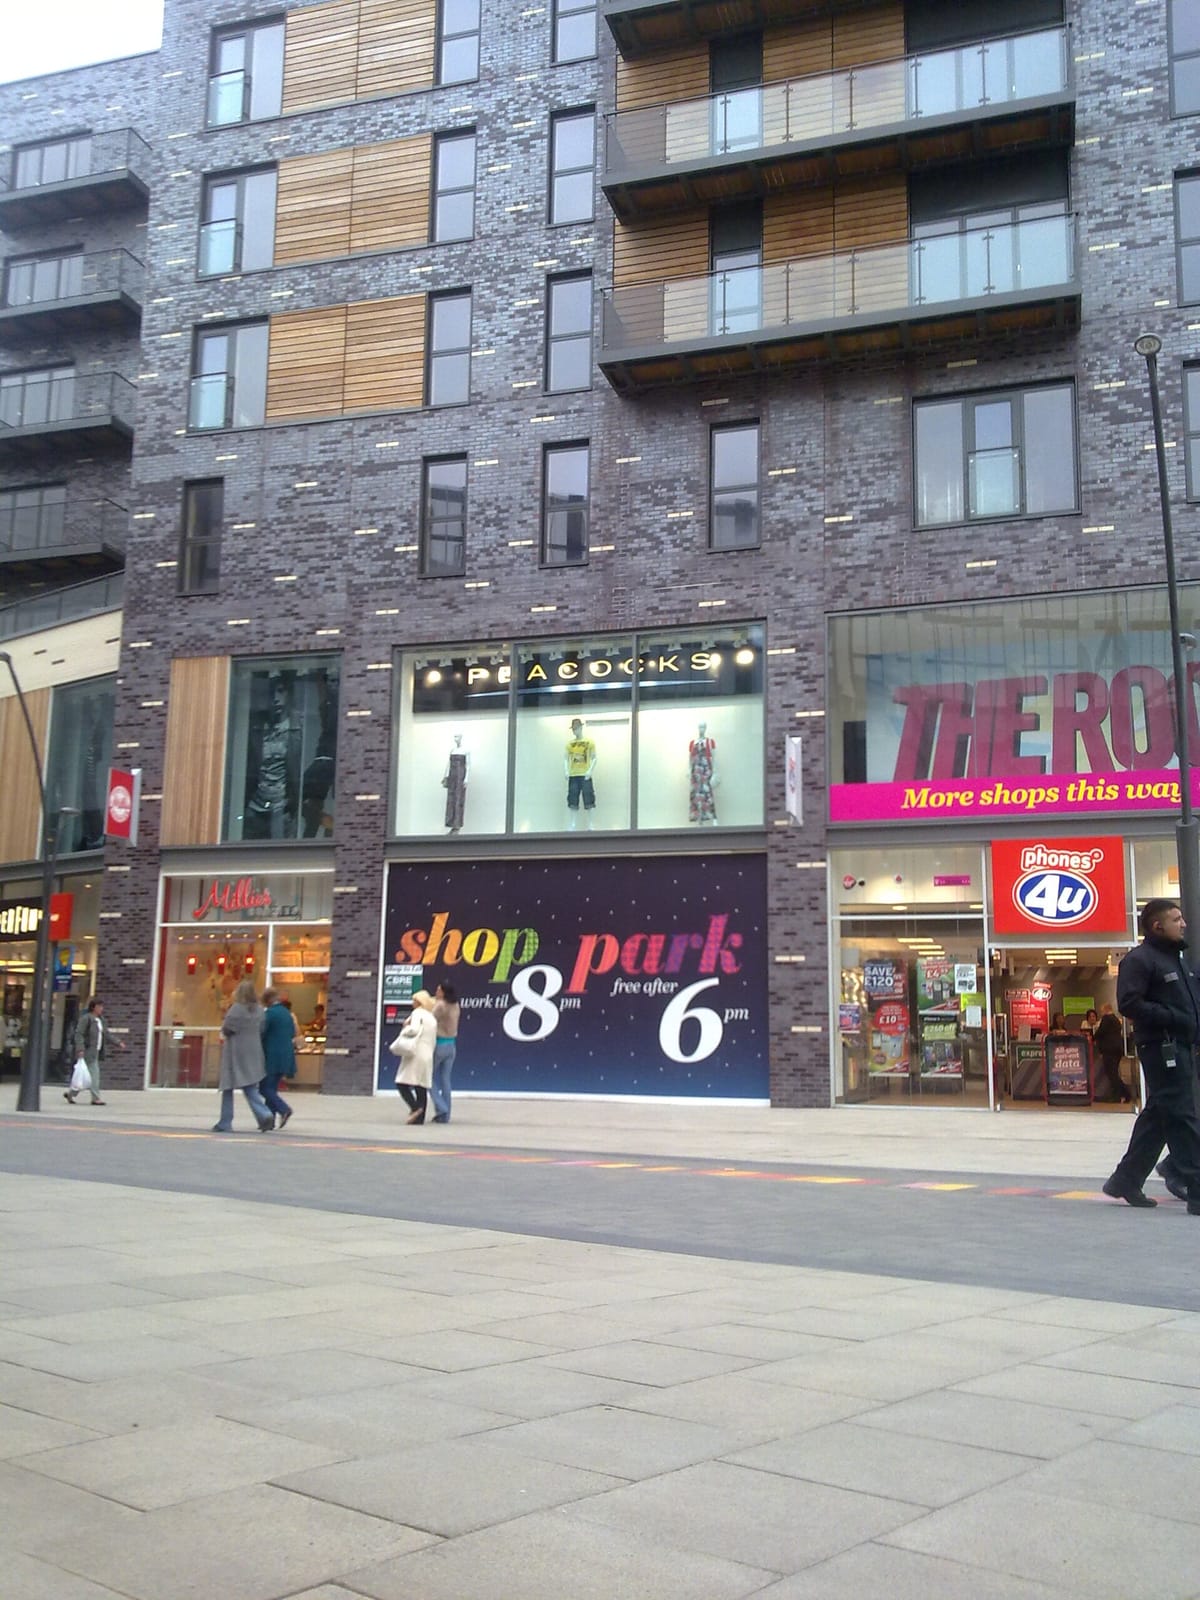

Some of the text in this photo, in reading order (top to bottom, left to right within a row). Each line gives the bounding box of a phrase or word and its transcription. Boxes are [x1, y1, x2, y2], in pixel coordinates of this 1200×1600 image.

[467, 652, 714, 685] PEACOCKS
[901, 779, 1183, 811] More shops this way
[1024, 847, 1093, 870] phones
[1025, 874, 1087, 917] 4u
[395, 911, 745, 995] shop park
[864, 976, 894, 987] £120
[865, 967, 894, 977] SAVE
[460, 963, 582, 1042] work til 8 pm
[610, 976, 750, 1064] free after 6 pm
